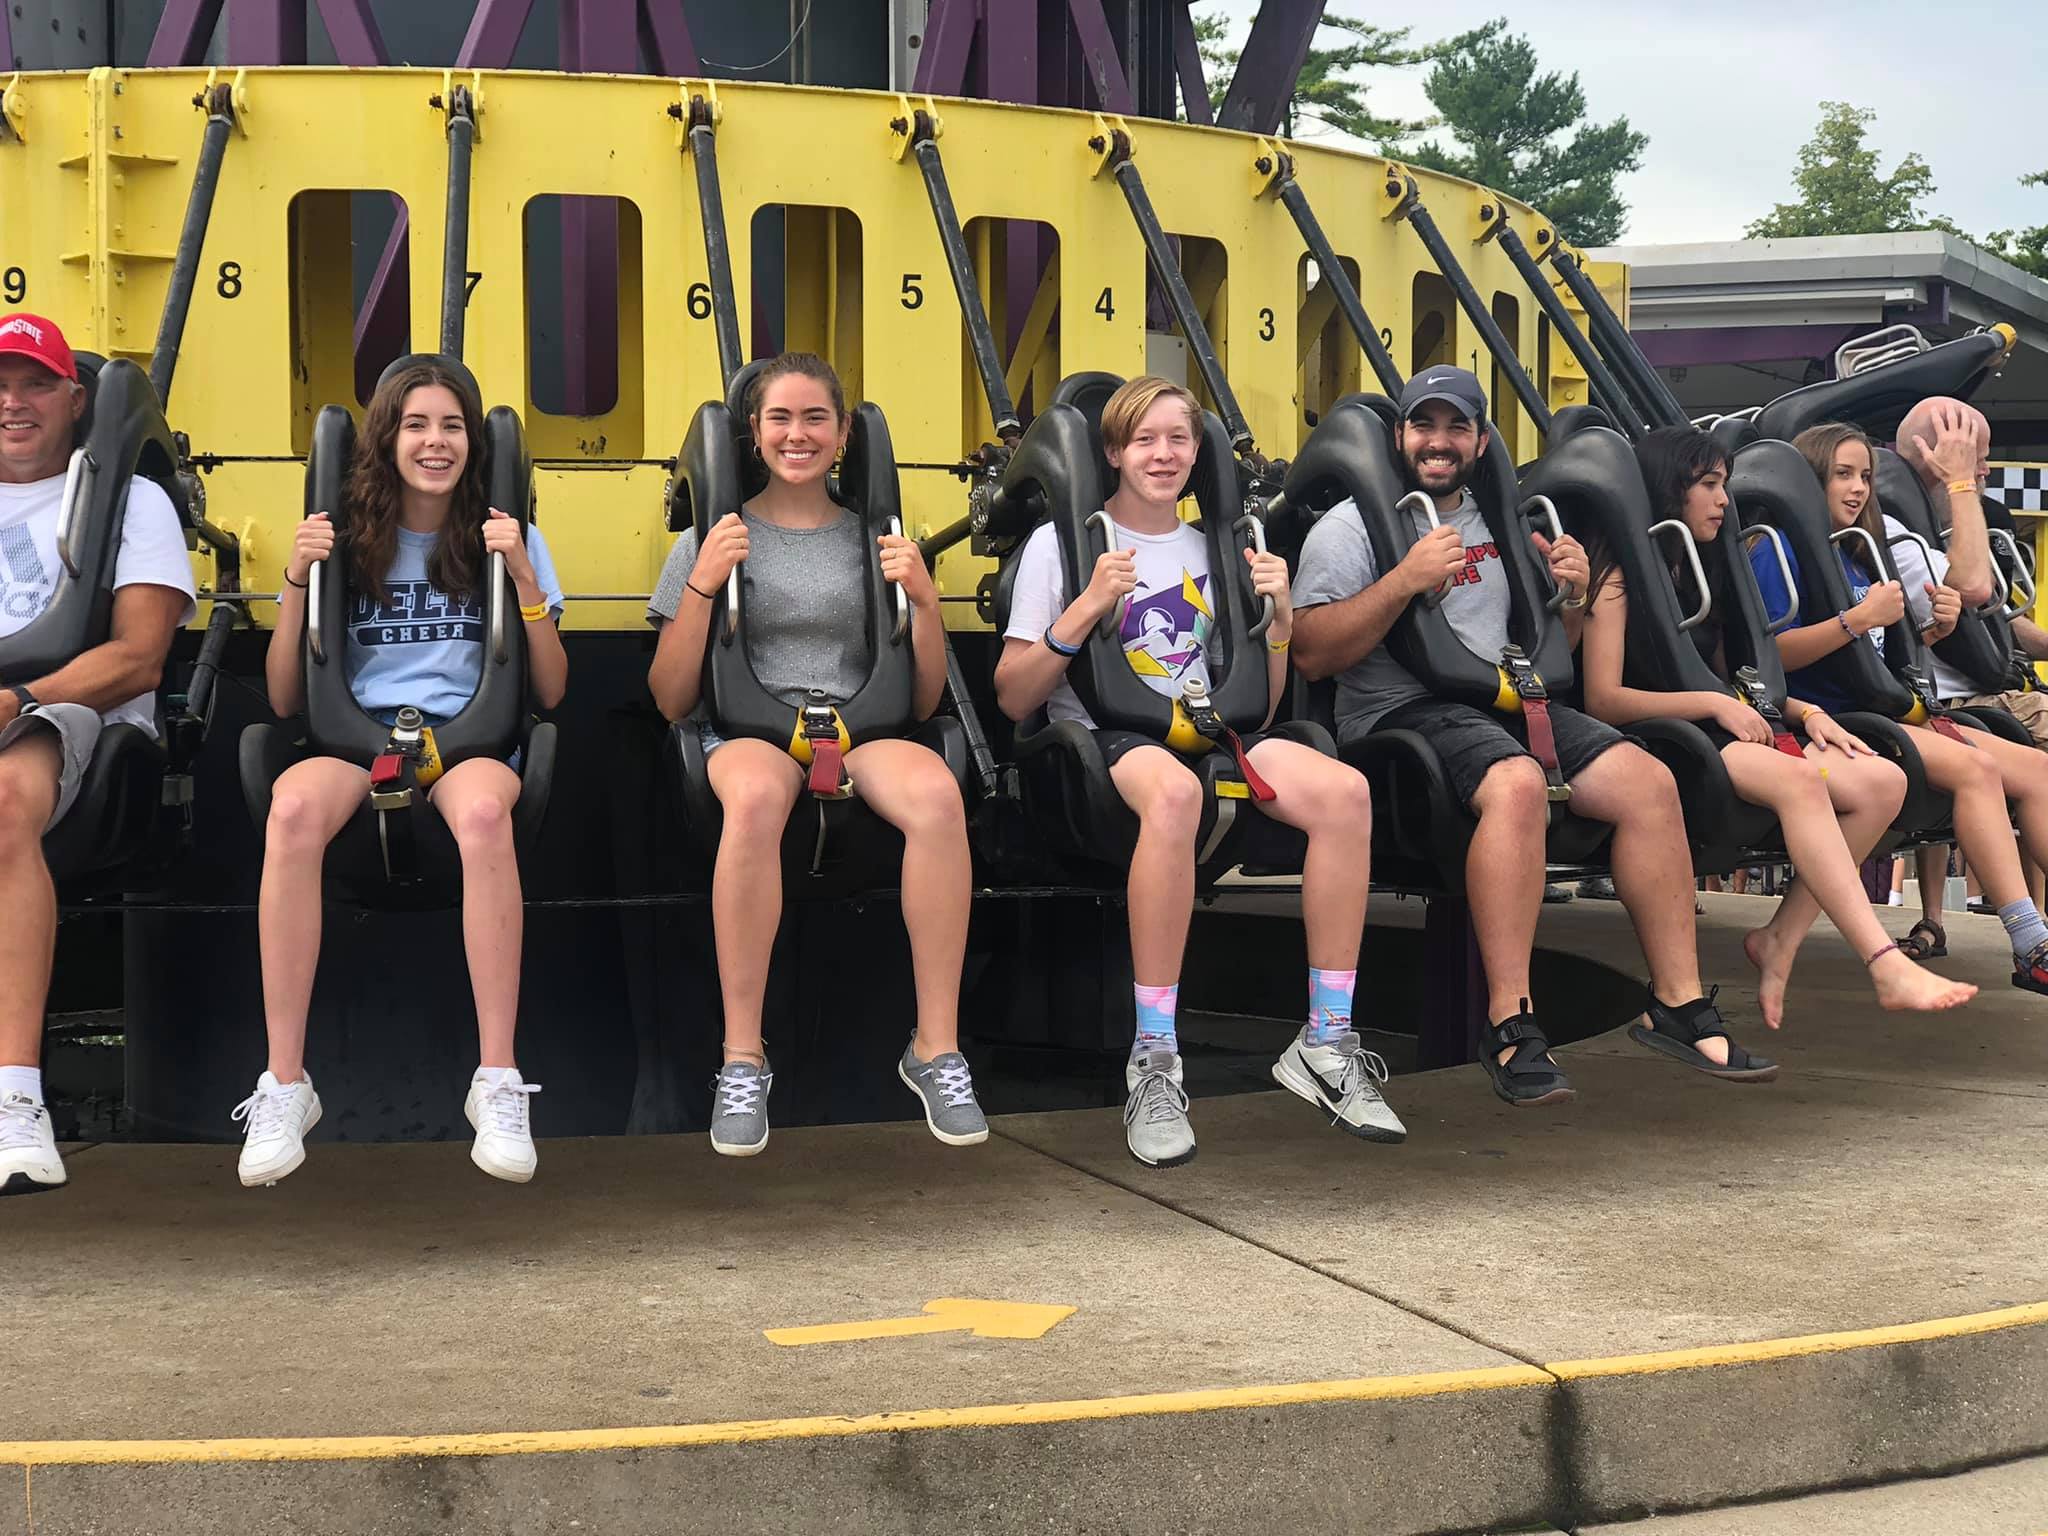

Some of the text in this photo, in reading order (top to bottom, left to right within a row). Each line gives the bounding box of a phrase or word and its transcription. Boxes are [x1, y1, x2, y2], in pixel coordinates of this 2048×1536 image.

[4, 267, 26, 304] 9
[217, 261, 242, 299] 8
[464, 272, 482, 308] 7
[901, 274, 924, 310] 5
[687, 283, 712, 319] 6
[1095, 287, 1115, 321] 4
[1259, 308, 1275, 341] 3
[1381, 328, 1393, 360] 2
[1471, 349, 1477, 377] 1
[381, 624, 464, 643] CHEER
